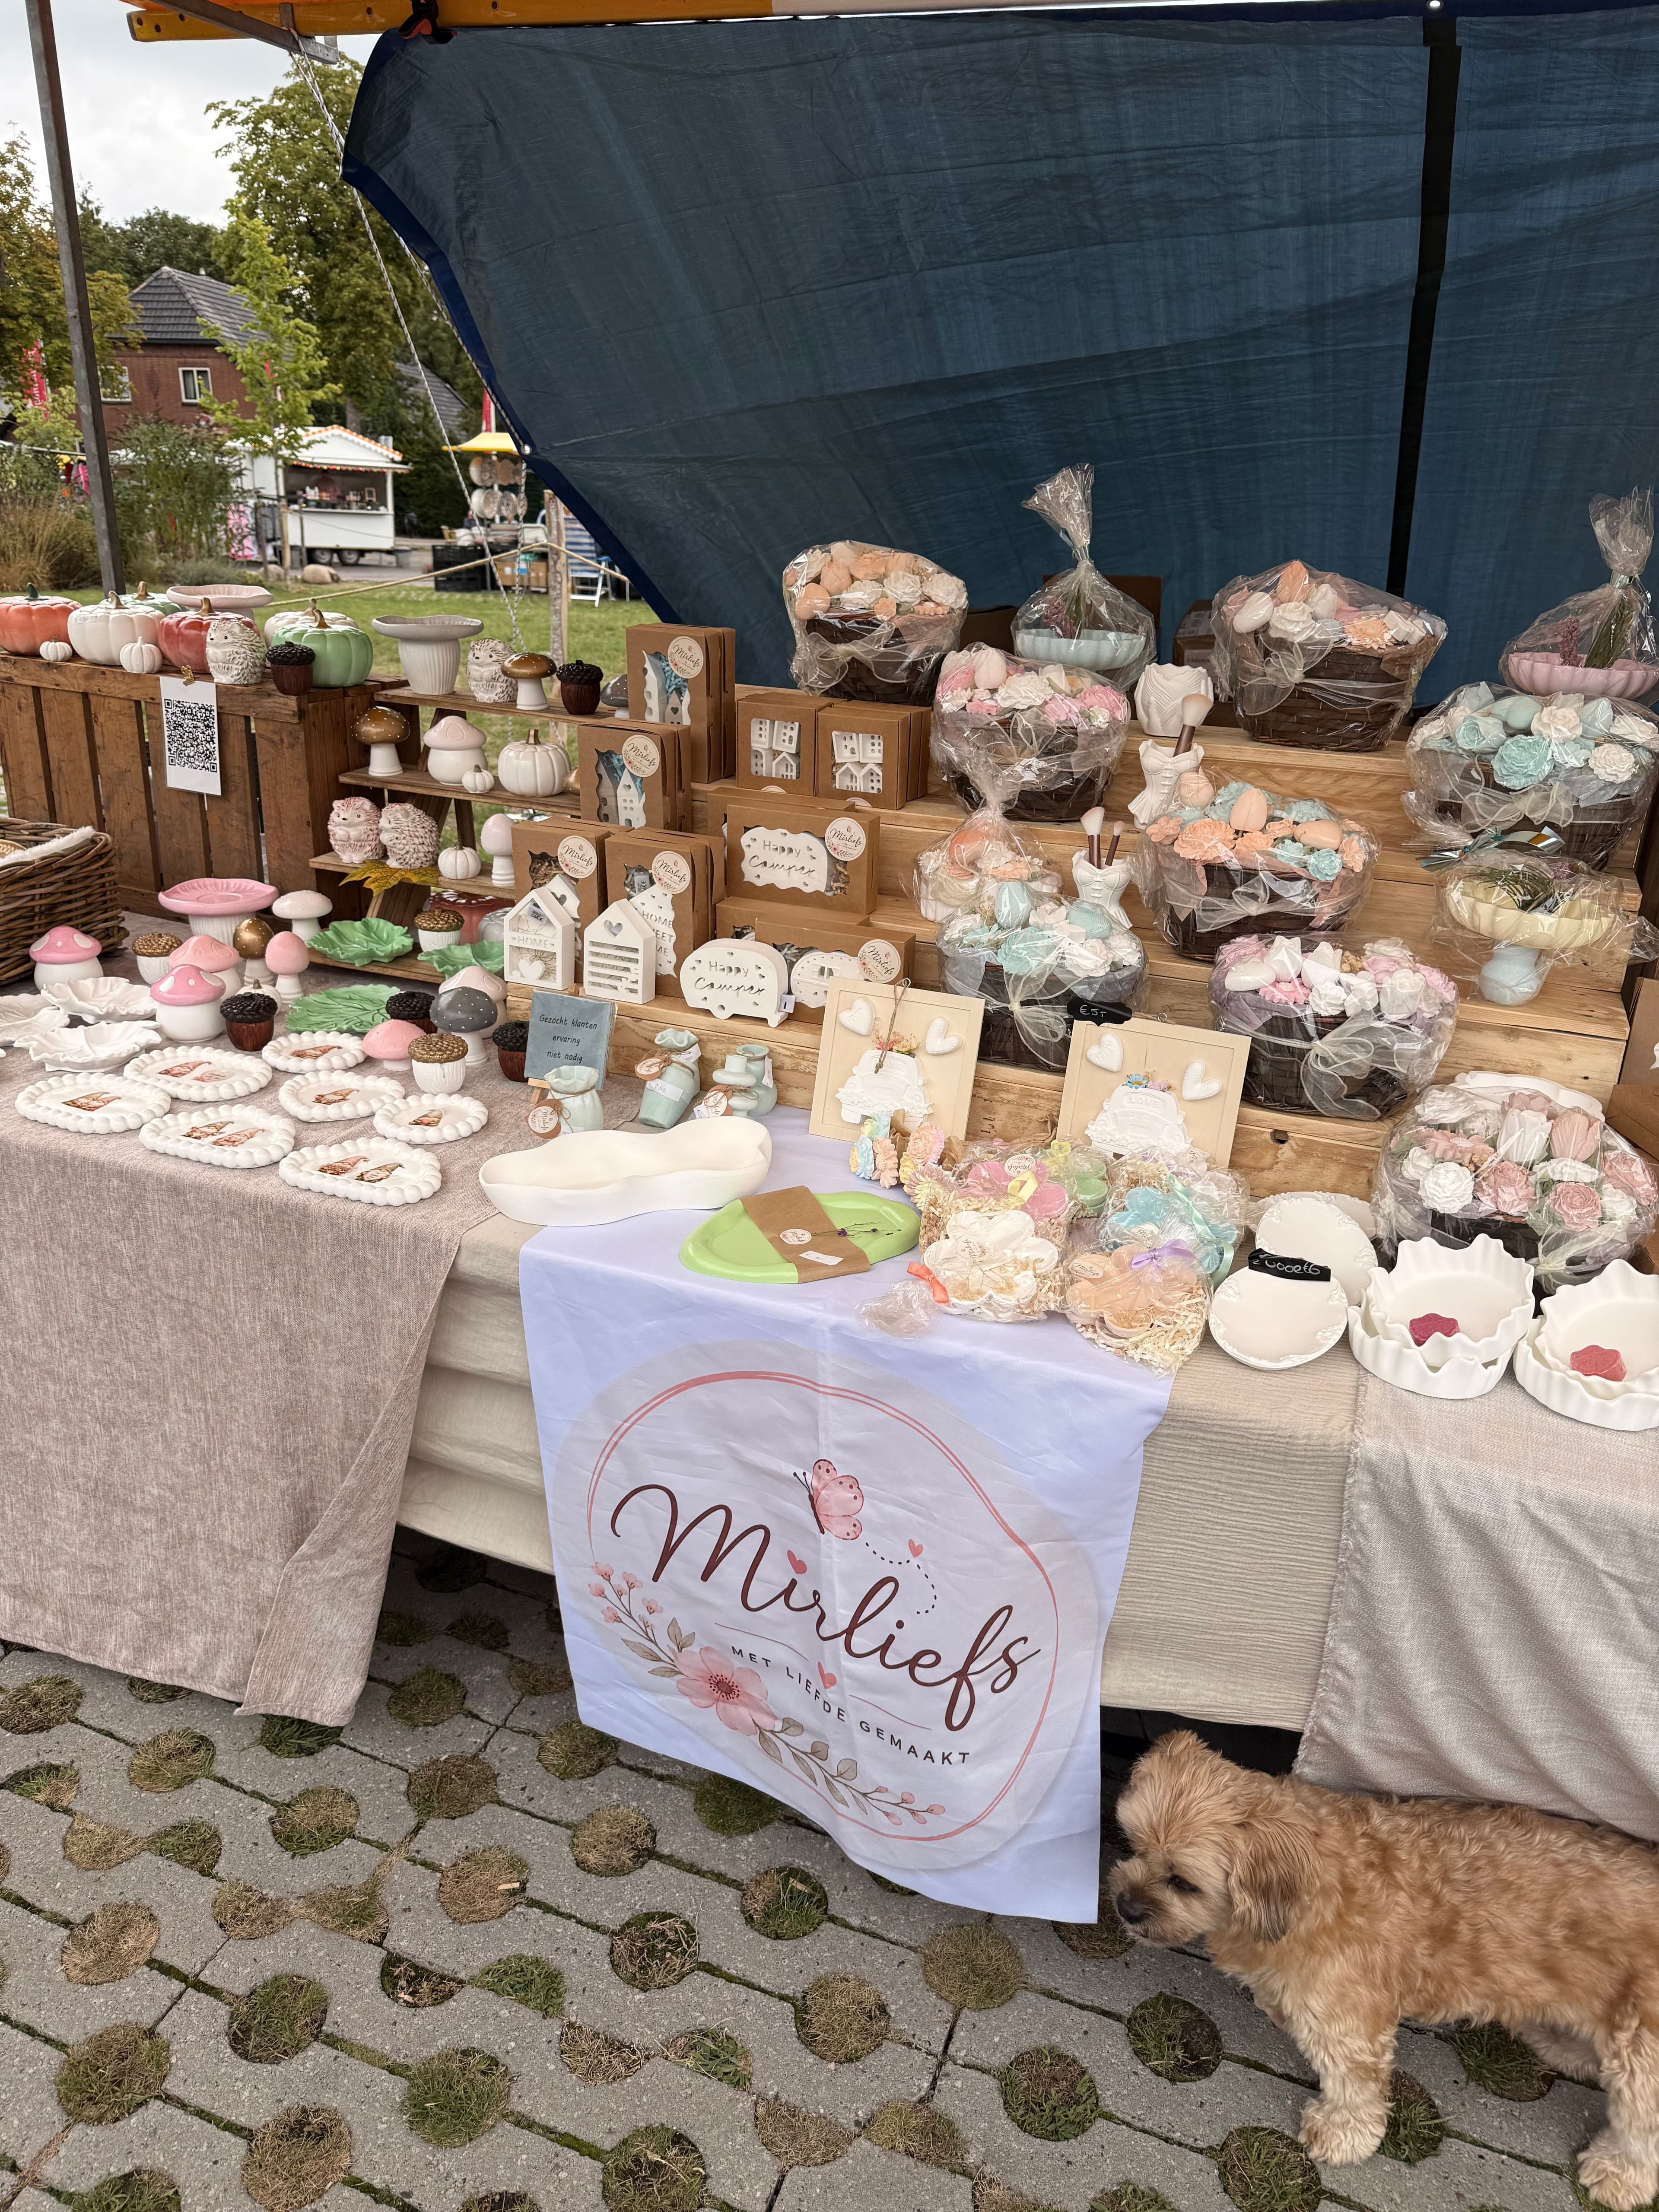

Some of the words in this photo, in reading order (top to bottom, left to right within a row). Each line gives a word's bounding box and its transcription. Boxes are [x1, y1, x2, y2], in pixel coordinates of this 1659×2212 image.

[673, 645, 700, 668] Mirliefs
[628, 743, 656, 766] Mirliefs
[830, 828, 862, 848] Mirliefs
[563, 845, 594, 866] Mirliefs
[763, 840, 801, 858] Happy
[657, 859, 686, 883] Mirliefs
[749, 855, 816, 877] Camper
[642, 911, 672, 928] HOME
[518, 936, 548, 948] HOME
[709, 961, 749, 977] Happy
[868, 946, 895, 975] Mirliefs
[695, 977, 765, 998] Camper
[540, 1014, 568, 1025] Gezocht
[571, 1018, 597, 1030] klanten
[553, 1036, 580, 1046] ervaring
[564, 1053, 583, 1064] nodig
[1130, 1096, 1159, 1107] LOVE
[610, 1484, 1041, 1731] Mirliefs
[731, 1645, 771, 1669] MET
[785, 1666, 846, 1723] LIEFDE
[859, 1720, 970, 1765] GEMAAKT
